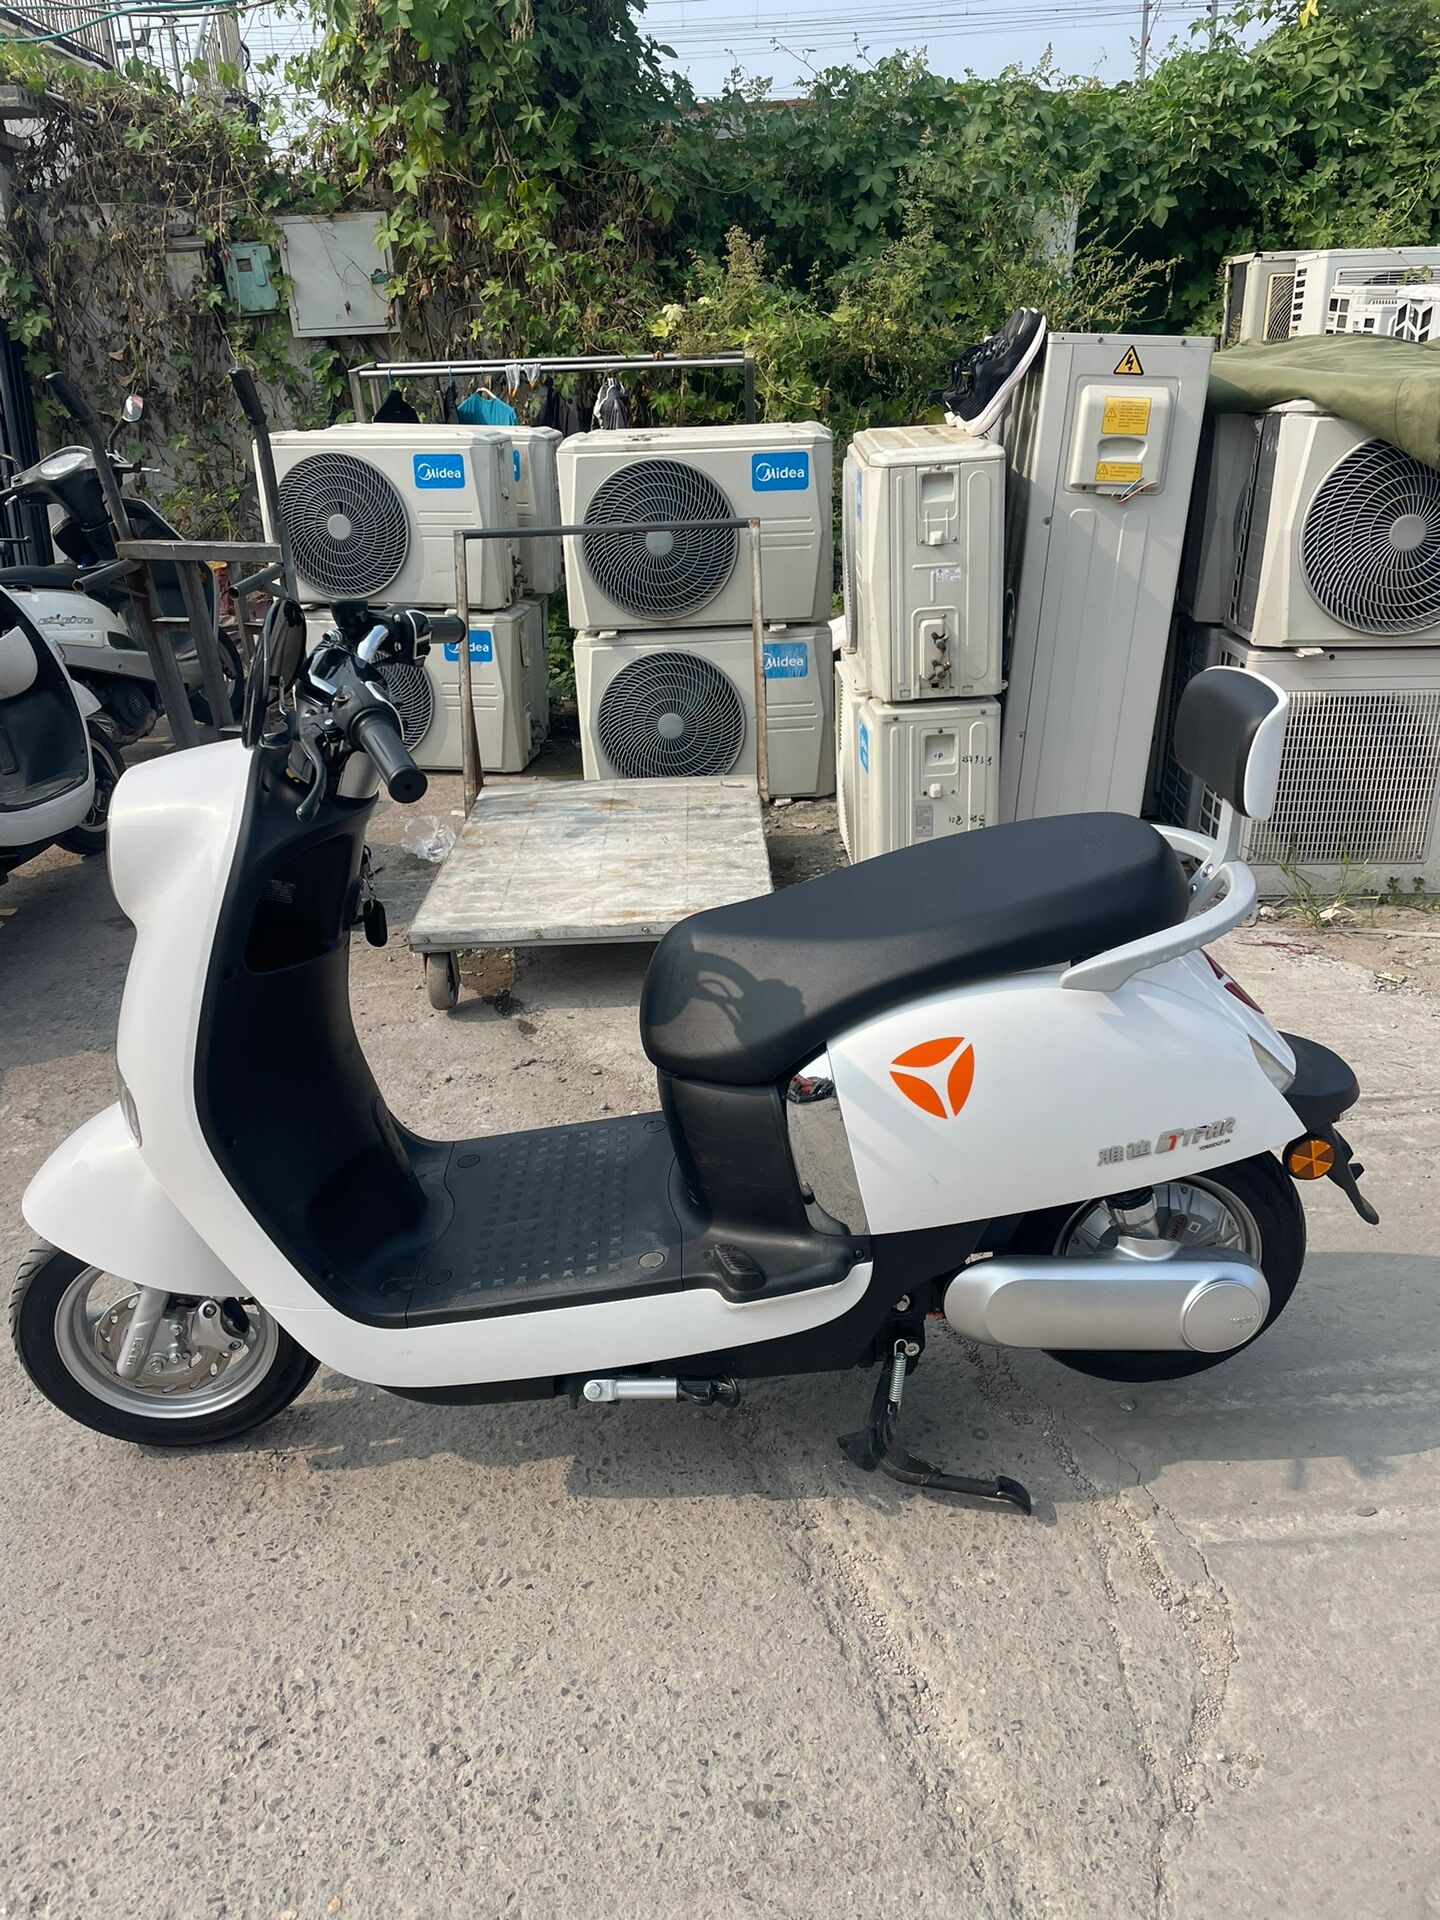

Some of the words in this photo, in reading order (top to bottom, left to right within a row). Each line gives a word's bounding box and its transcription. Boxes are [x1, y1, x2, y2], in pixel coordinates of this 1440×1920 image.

[417, 463, 461, 481] Midea
[755, 462, 805, 482] Midea
[763, 652, 804, 670] Midea
